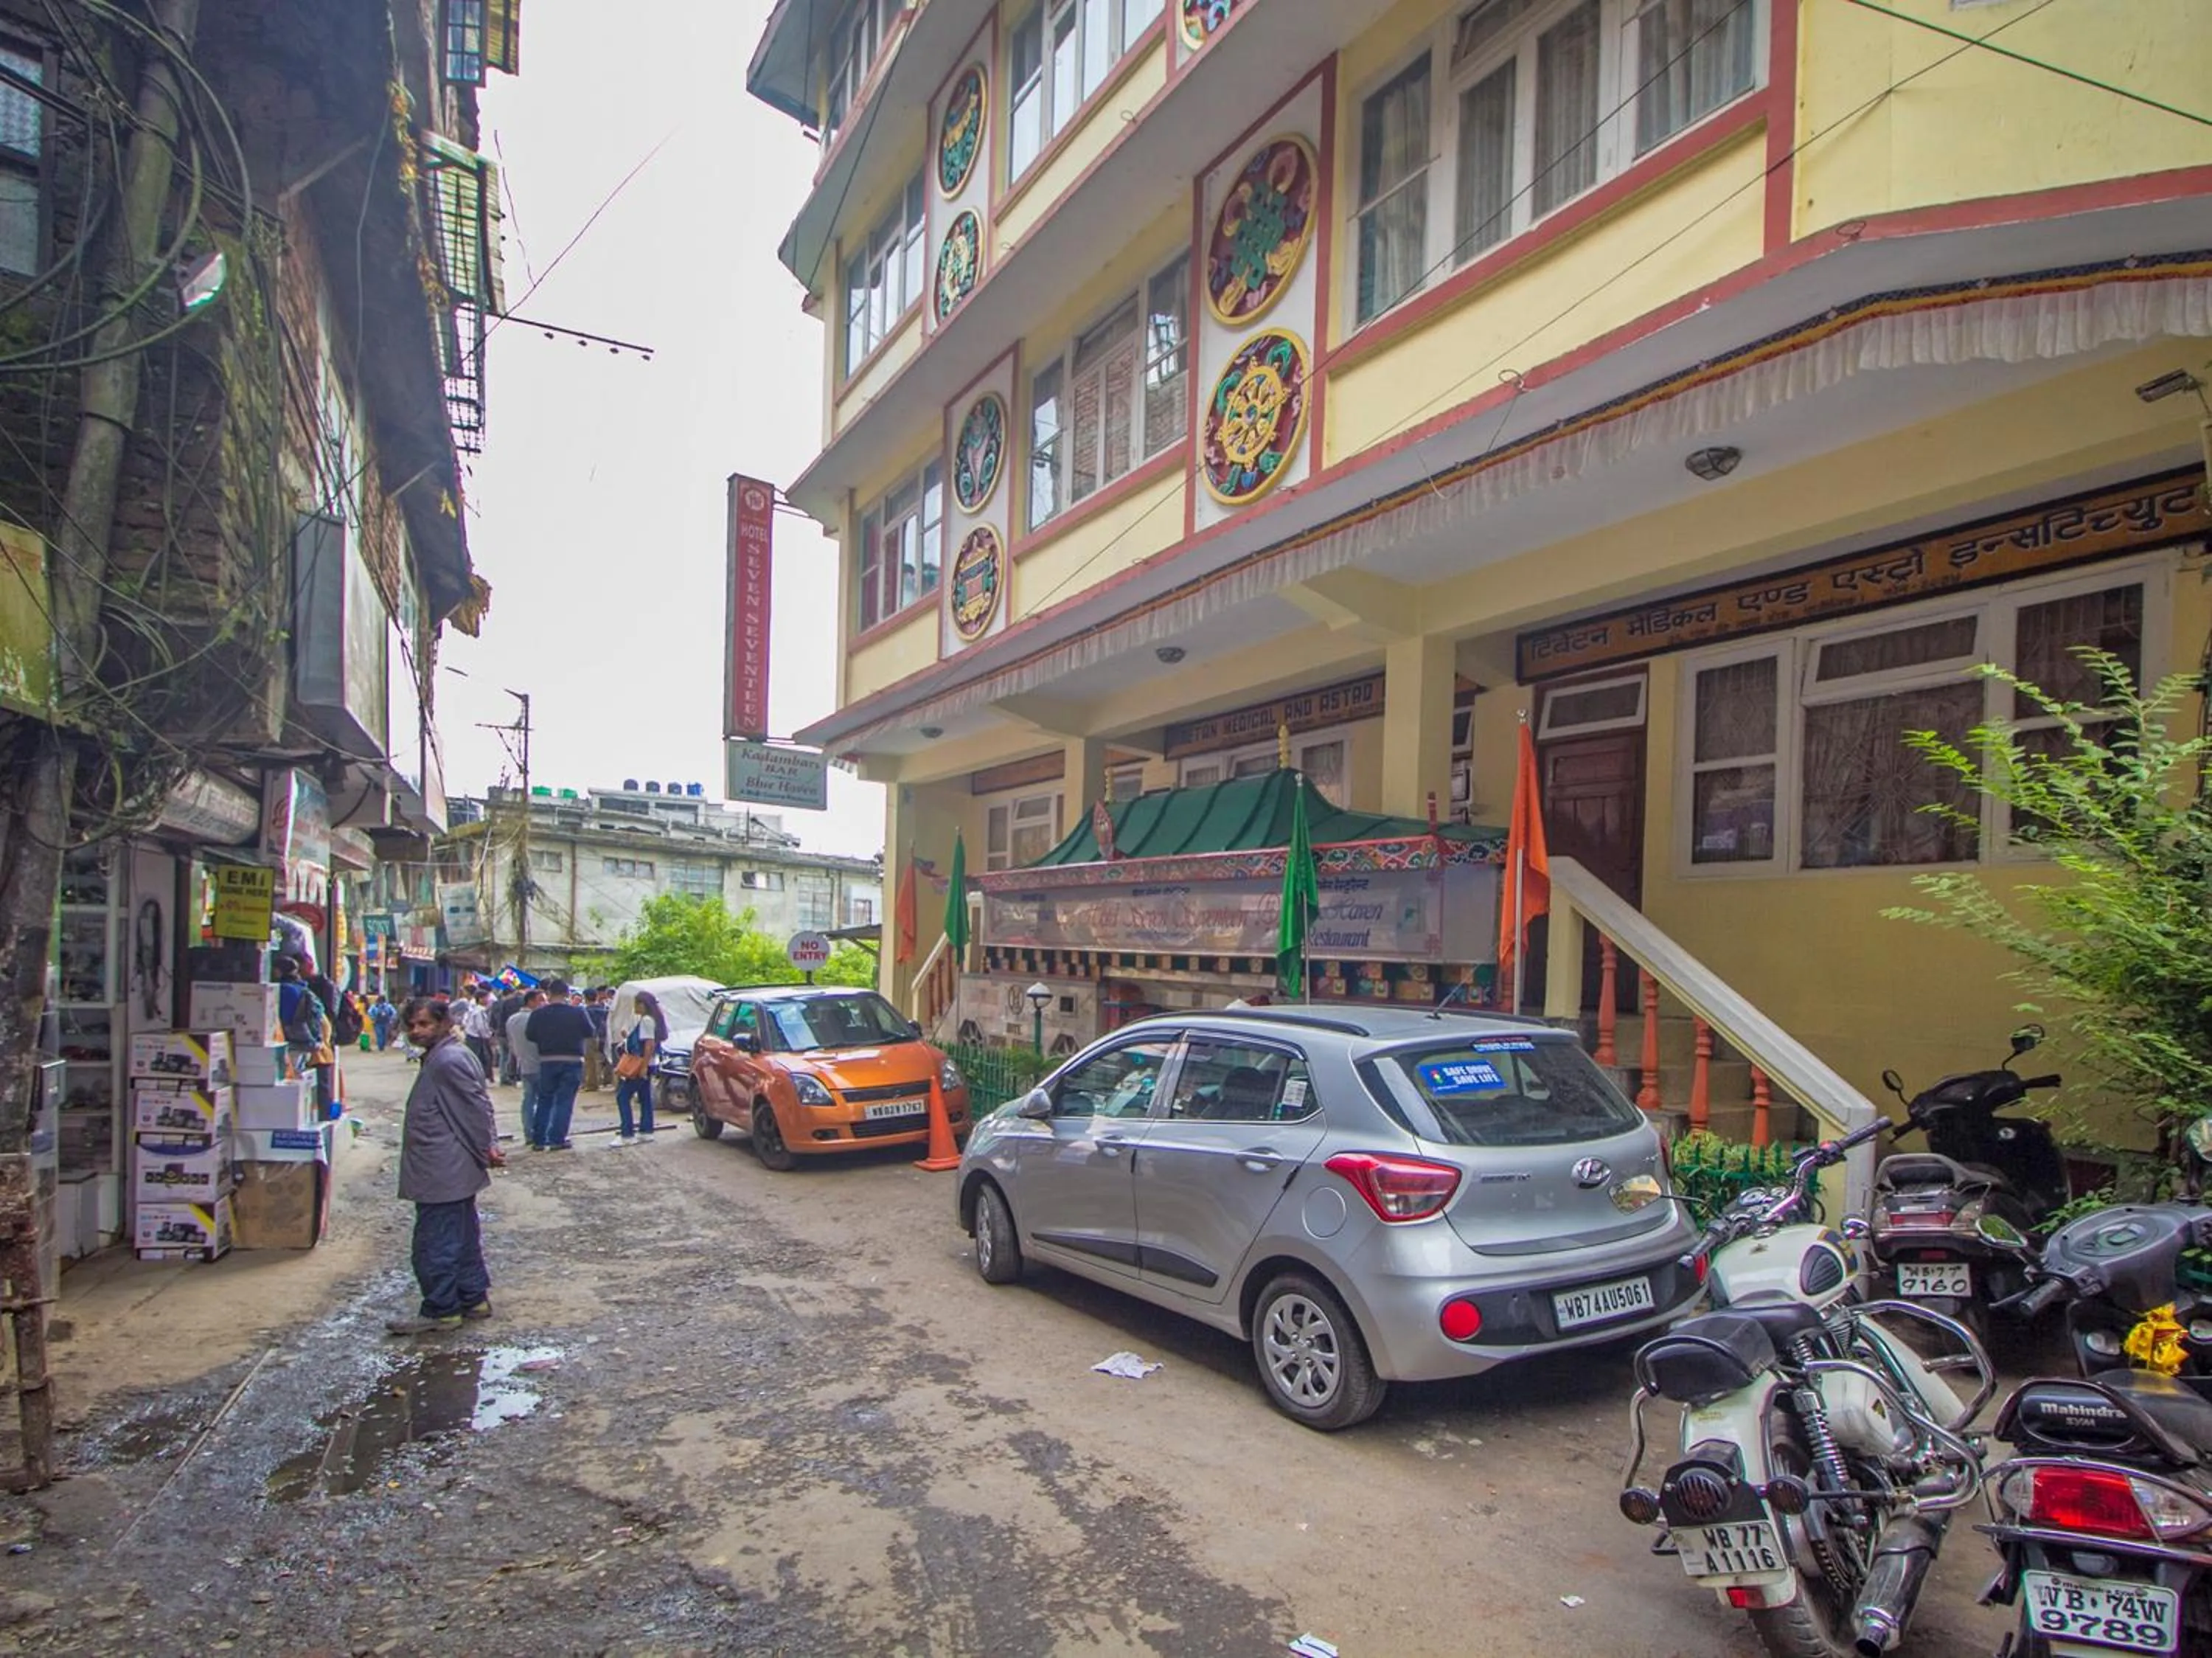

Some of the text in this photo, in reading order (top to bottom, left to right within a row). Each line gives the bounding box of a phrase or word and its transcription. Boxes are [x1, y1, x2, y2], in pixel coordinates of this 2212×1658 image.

[741, 522, 768, 544] HOTEL
[745, 543, 761, 606] SEVEN
[1737, 580, 1812, 611] एण्ड
[743, 613, 759, 726] SEVENTEEN
[765, 763, 799, 776] BAR
[228, 871, 265, 886] EMI
[801, 940, 818, 950] NO
[793, 951, 826, 961] ENTRY
[1442, 1064, 1495, 1077] SAFE DRIVE
[1453, 1072, 1501, 1085] SAVE LIFE
[1902, 1279, 1968, 1293] 9160
[1564, 1283, 1649, 1320] WB74AU5061
[2040, 1402, 2127, 1418] Mahindra
[1703, 1525, 1761, 1549] WB 77
[1705, 1548, 1775, 1572] A1116
[2040, 1609, 2168, 1646] 9789
